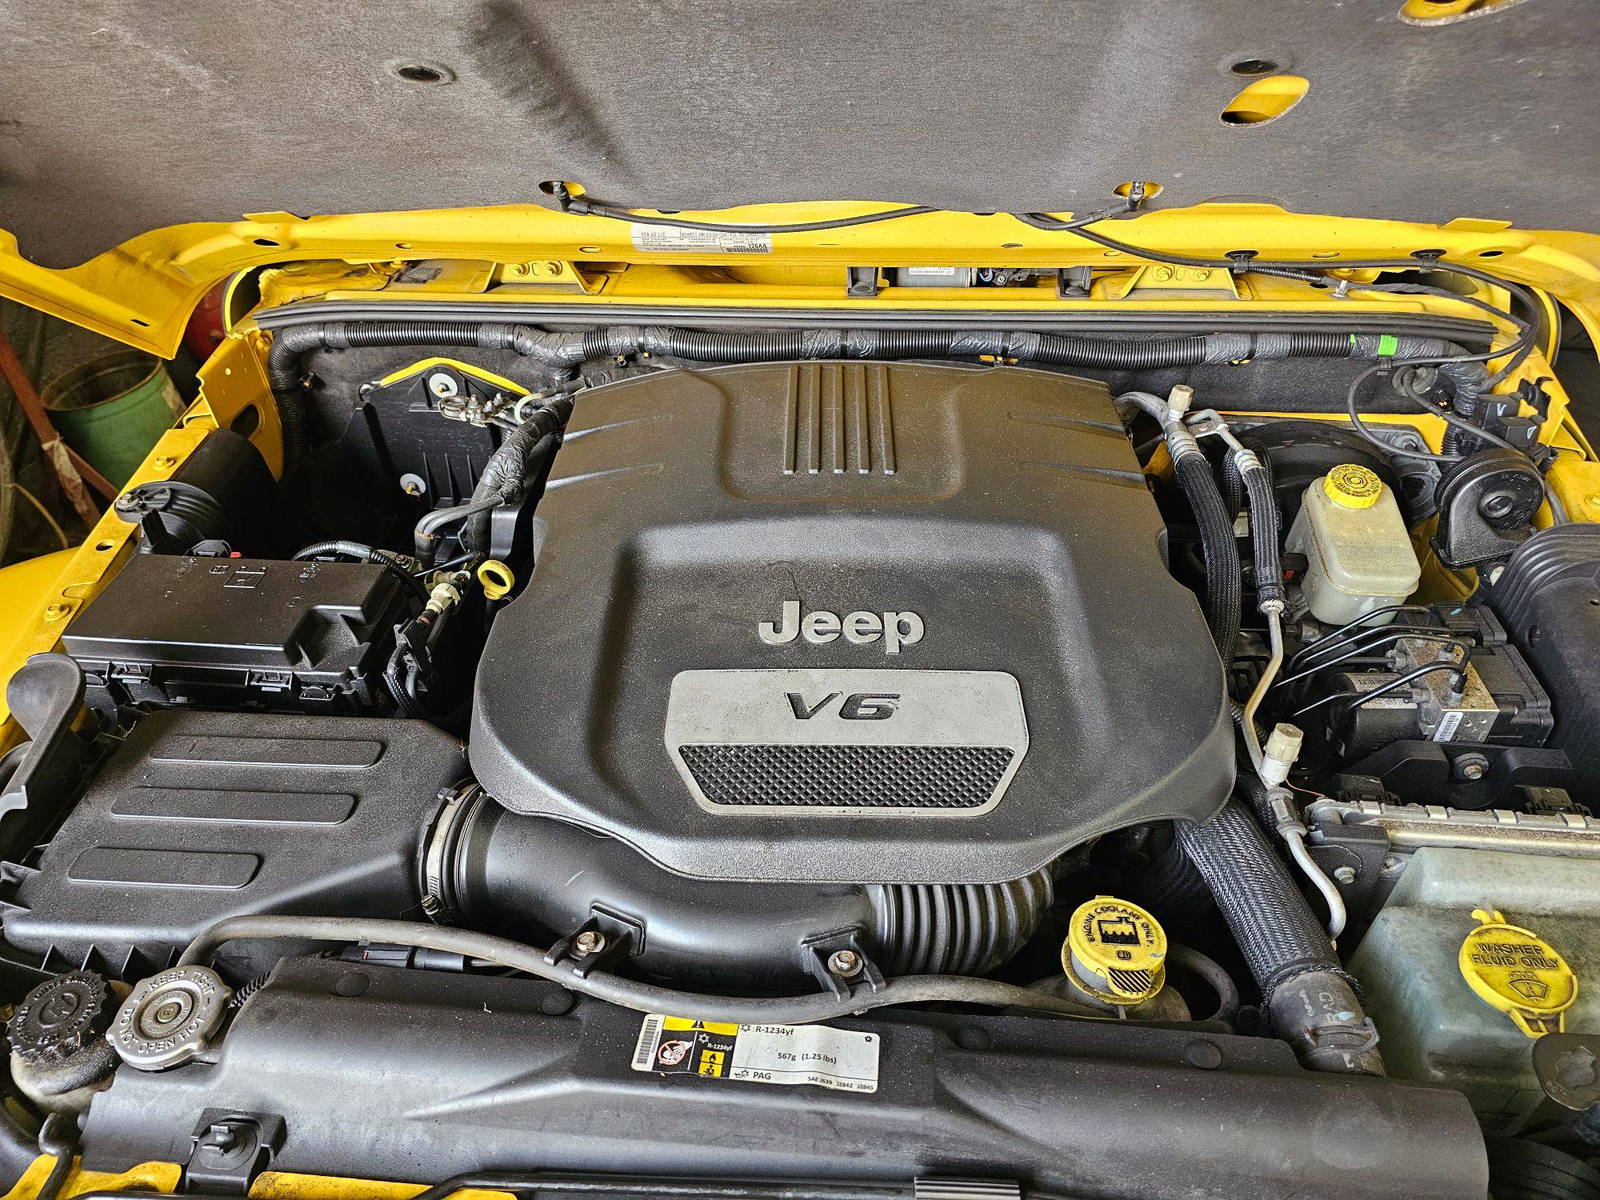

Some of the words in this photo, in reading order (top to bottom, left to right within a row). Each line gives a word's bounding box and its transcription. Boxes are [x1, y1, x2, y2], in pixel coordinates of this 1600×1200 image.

[758, 600, 925, 655] Jeep
[785, 691, 901, 720] V6
[1083, 913, 1096, 943] ENGINE
[1095, 905, 1142, 921] COOLANT
[1476, 942, 1544, 956] WASHER
[1471, 954, 1516, 967] FLUID
[1520, 957, 1559, 969] ONLY
[148, 970, 187, 991] KEEP
[120, 1008, 135, 1026] DO
[120, 1026, 139, 1048] NOT
[179, 1015, 204, 1041] HOT
[755, 1025, 794, 1036] R-1234yf
[138, 1037, 176, 1054] OPEN
[777, 1052, 796, 1061] 567g
[822, 1053, 837, 1064] lbs)
[753, 1071, 771, 1080] PAG
